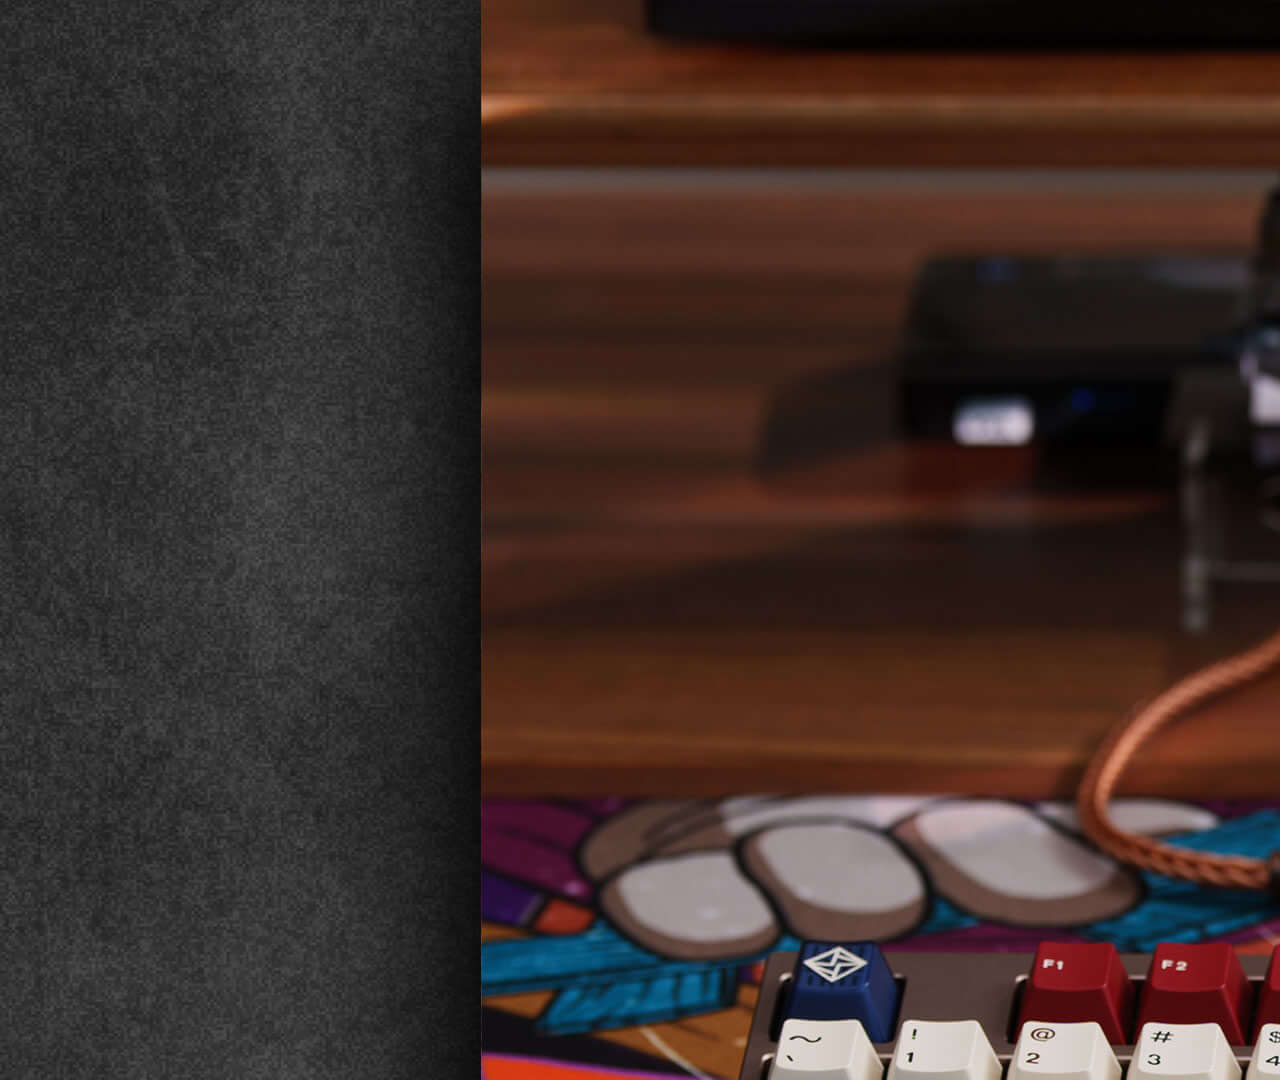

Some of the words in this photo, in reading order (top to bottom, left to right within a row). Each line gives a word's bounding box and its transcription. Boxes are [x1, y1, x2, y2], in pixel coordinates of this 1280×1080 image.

[1042, 958, 1064, 971] F1
[1161, 959, 1188, 971] F2
[905, 1052, 914, 1063] 1
[1025, 1052, 1041, 1065] 2
[1147, 1053, 1161, 1066] 3
[1265, 1055, 1280, 1067] 4
